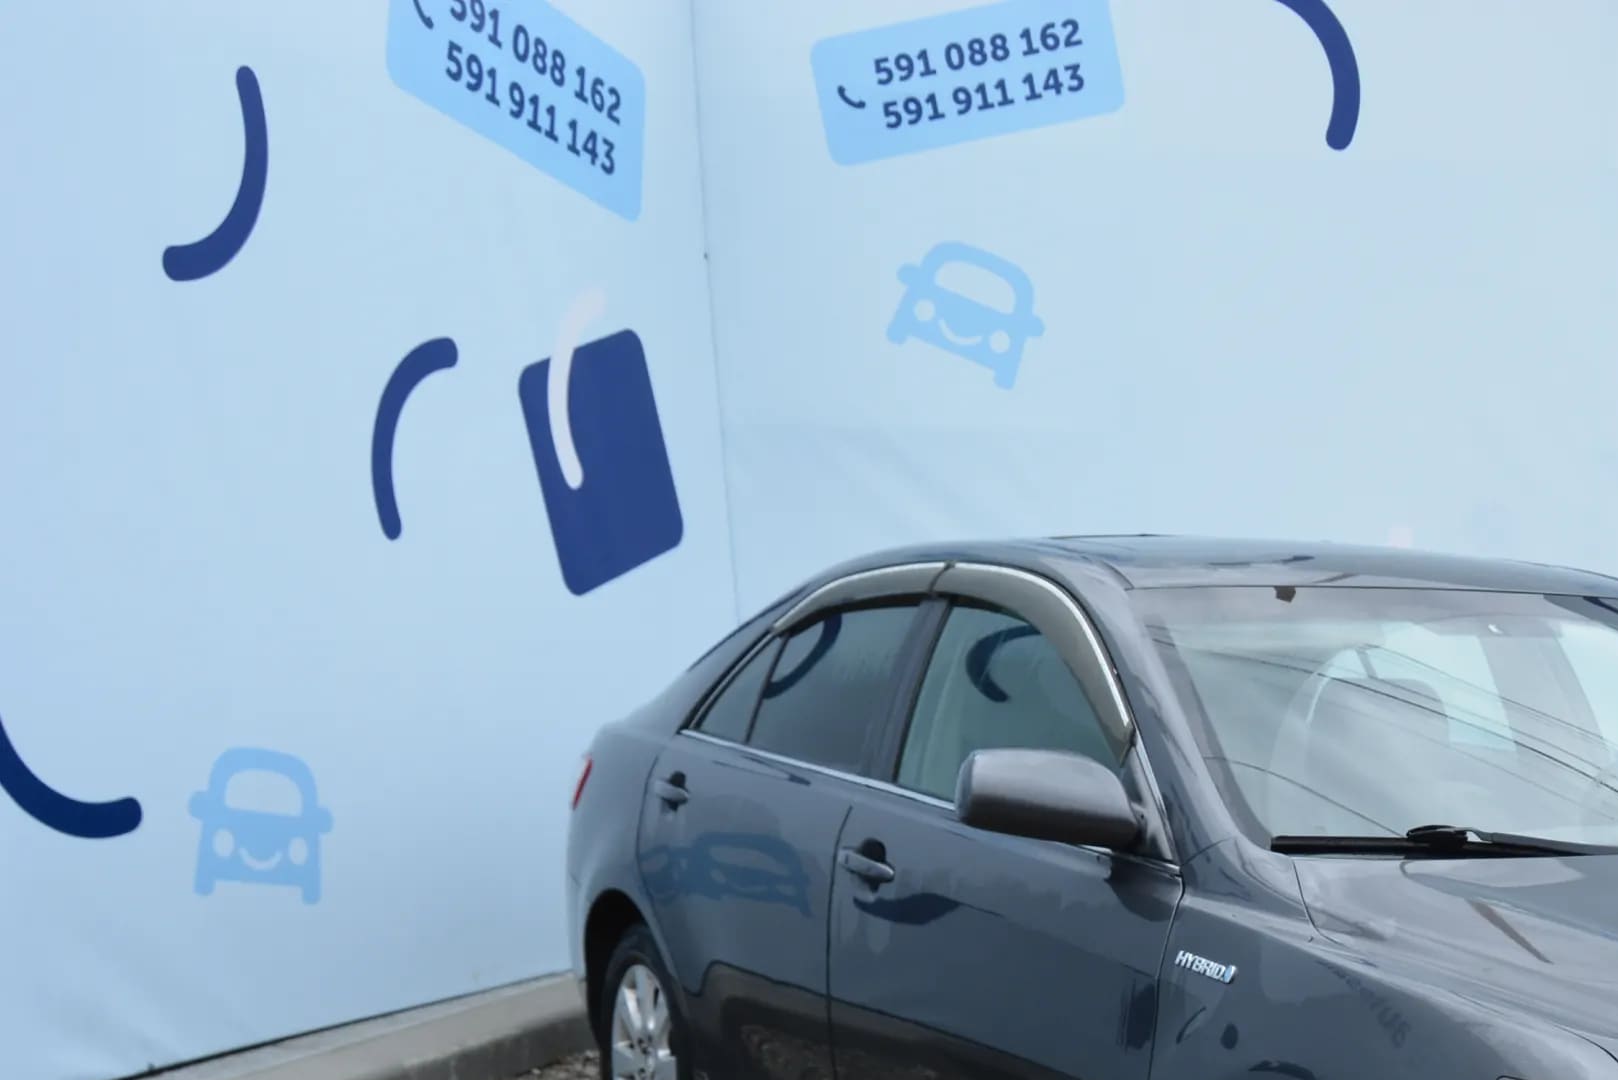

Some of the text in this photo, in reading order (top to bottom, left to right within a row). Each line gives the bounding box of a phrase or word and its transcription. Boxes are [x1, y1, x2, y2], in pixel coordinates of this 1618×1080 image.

[449, 0, 621, 125] 591 088 162
[874, 18, 1083, 86] 591 088 162
[445, 39, 616, 176] 591 911 143
[883, 63, 1085, 129] 591 911 143
[1174, 949, 1227, 982] HYBRID
